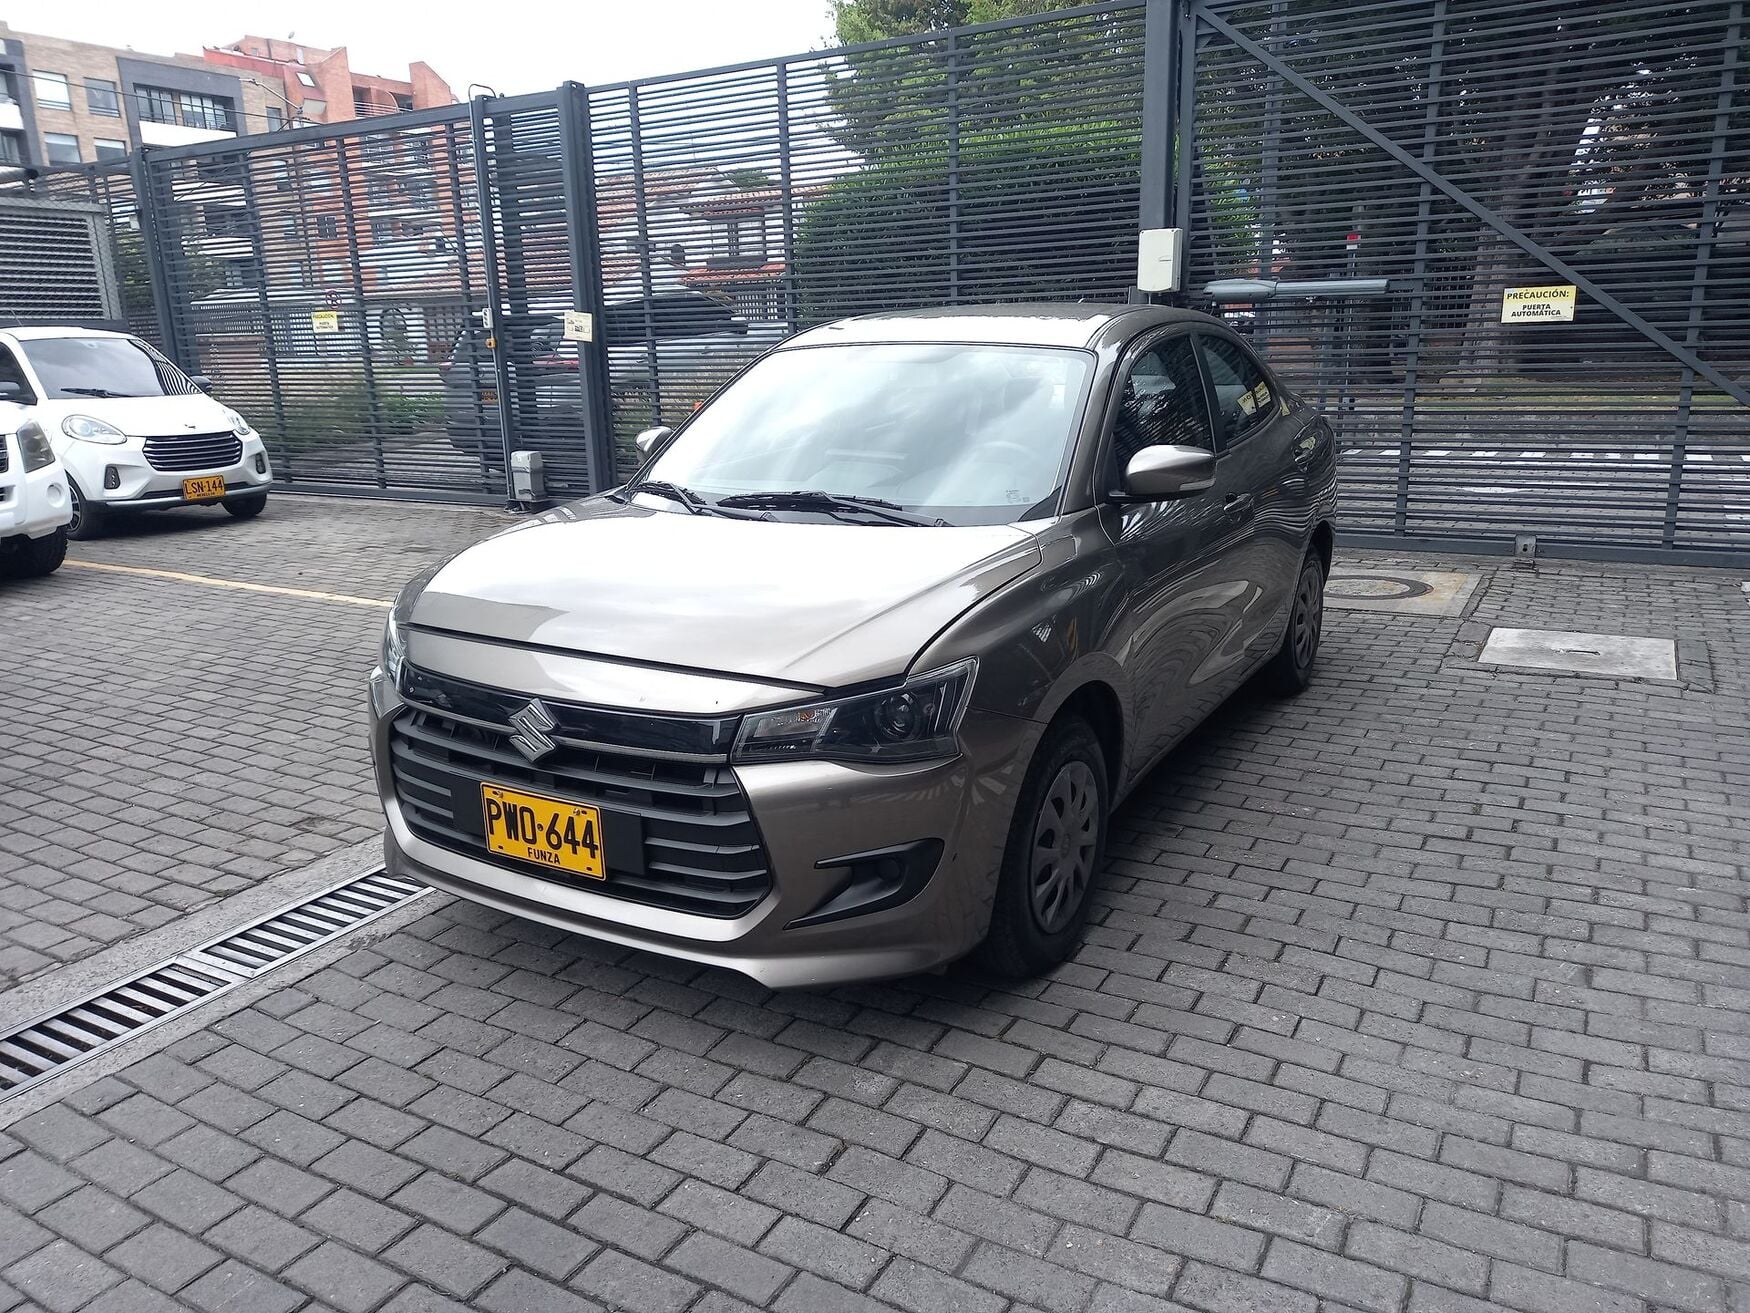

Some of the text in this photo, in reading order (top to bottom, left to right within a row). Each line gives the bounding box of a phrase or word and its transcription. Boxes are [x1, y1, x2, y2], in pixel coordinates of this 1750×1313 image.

[1506, 289, 1569, 300] PRECAUCIÓN:
[1522, 303, 1551, 311] PUERTA
[1511, 309, 1561, 318] AUTOMÁTICA
[527, 847, 561, 865] FUNZA
